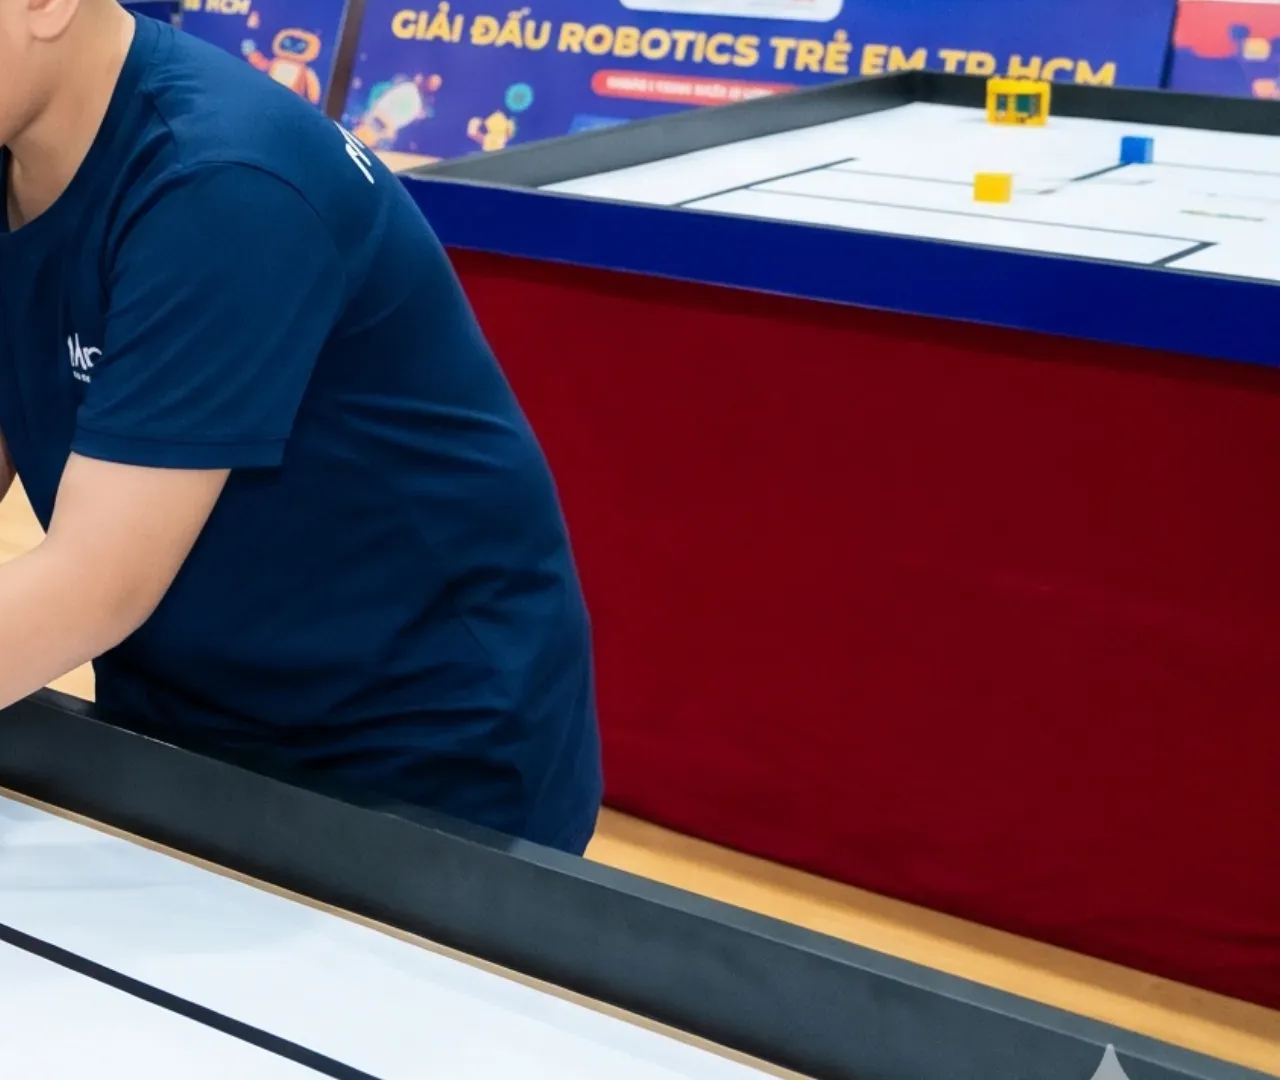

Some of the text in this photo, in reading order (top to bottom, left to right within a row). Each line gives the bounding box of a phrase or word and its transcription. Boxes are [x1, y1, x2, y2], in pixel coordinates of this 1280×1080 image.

[391, 1, 1117, 88] GIẢI ĐẤU ROBOTICS TRẺ EM TPHCM
